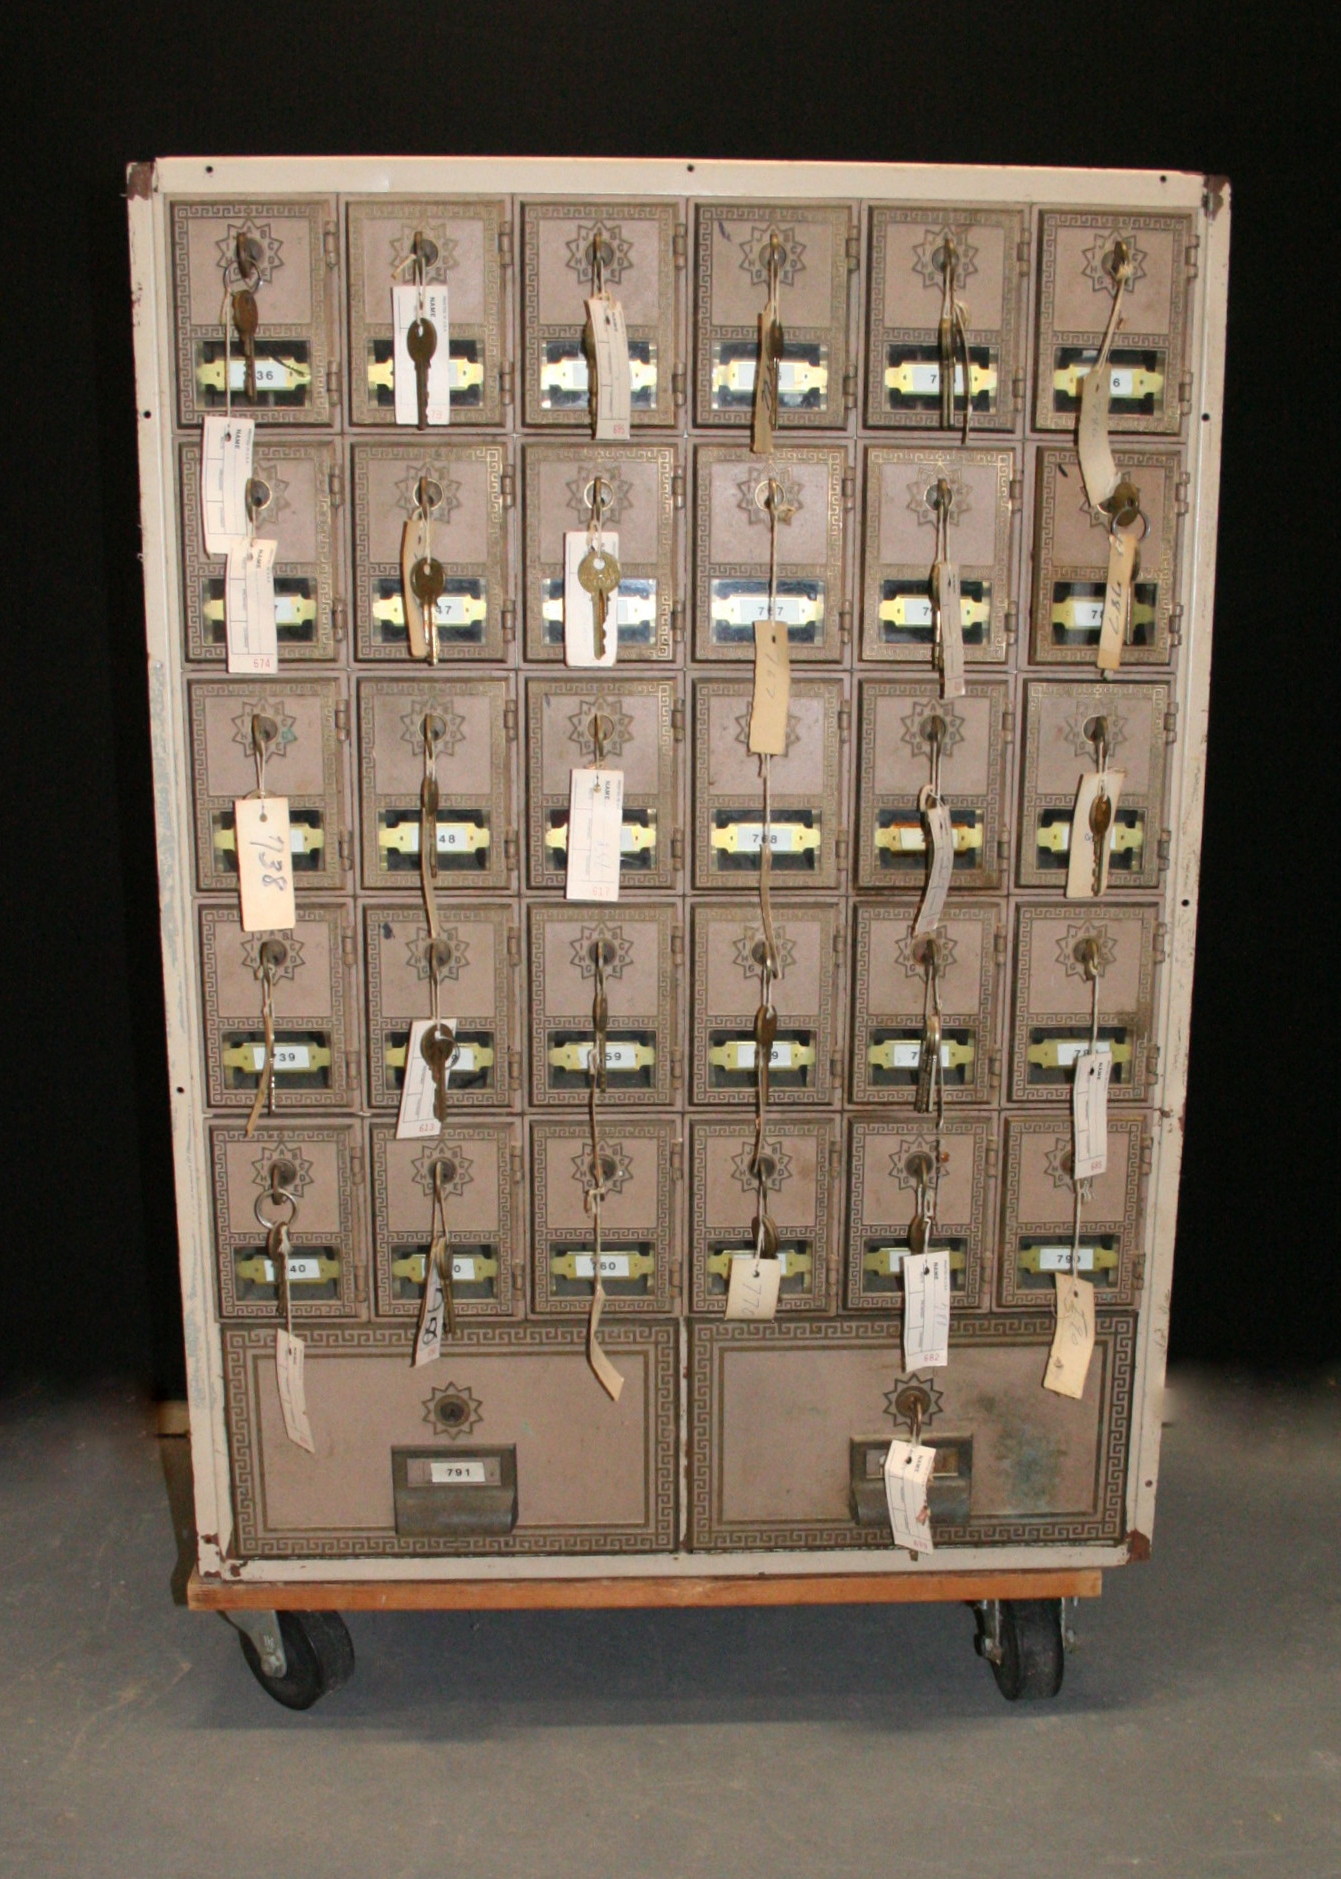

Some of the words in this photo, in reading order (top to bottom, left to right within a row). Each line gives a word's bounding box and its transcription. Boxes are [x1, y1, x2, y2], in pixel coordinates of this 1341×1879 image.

[256, 370, 274, 381] 36
[436, 605, 452, 615] 47
[439, 834, 455, 845] 48
[276, 1052, 296, 1063] 39
[605, 1052, 622, 1062] 59
[289, 1264, 307, 1274] 40
[447, 1468, 471, 1477] 791
